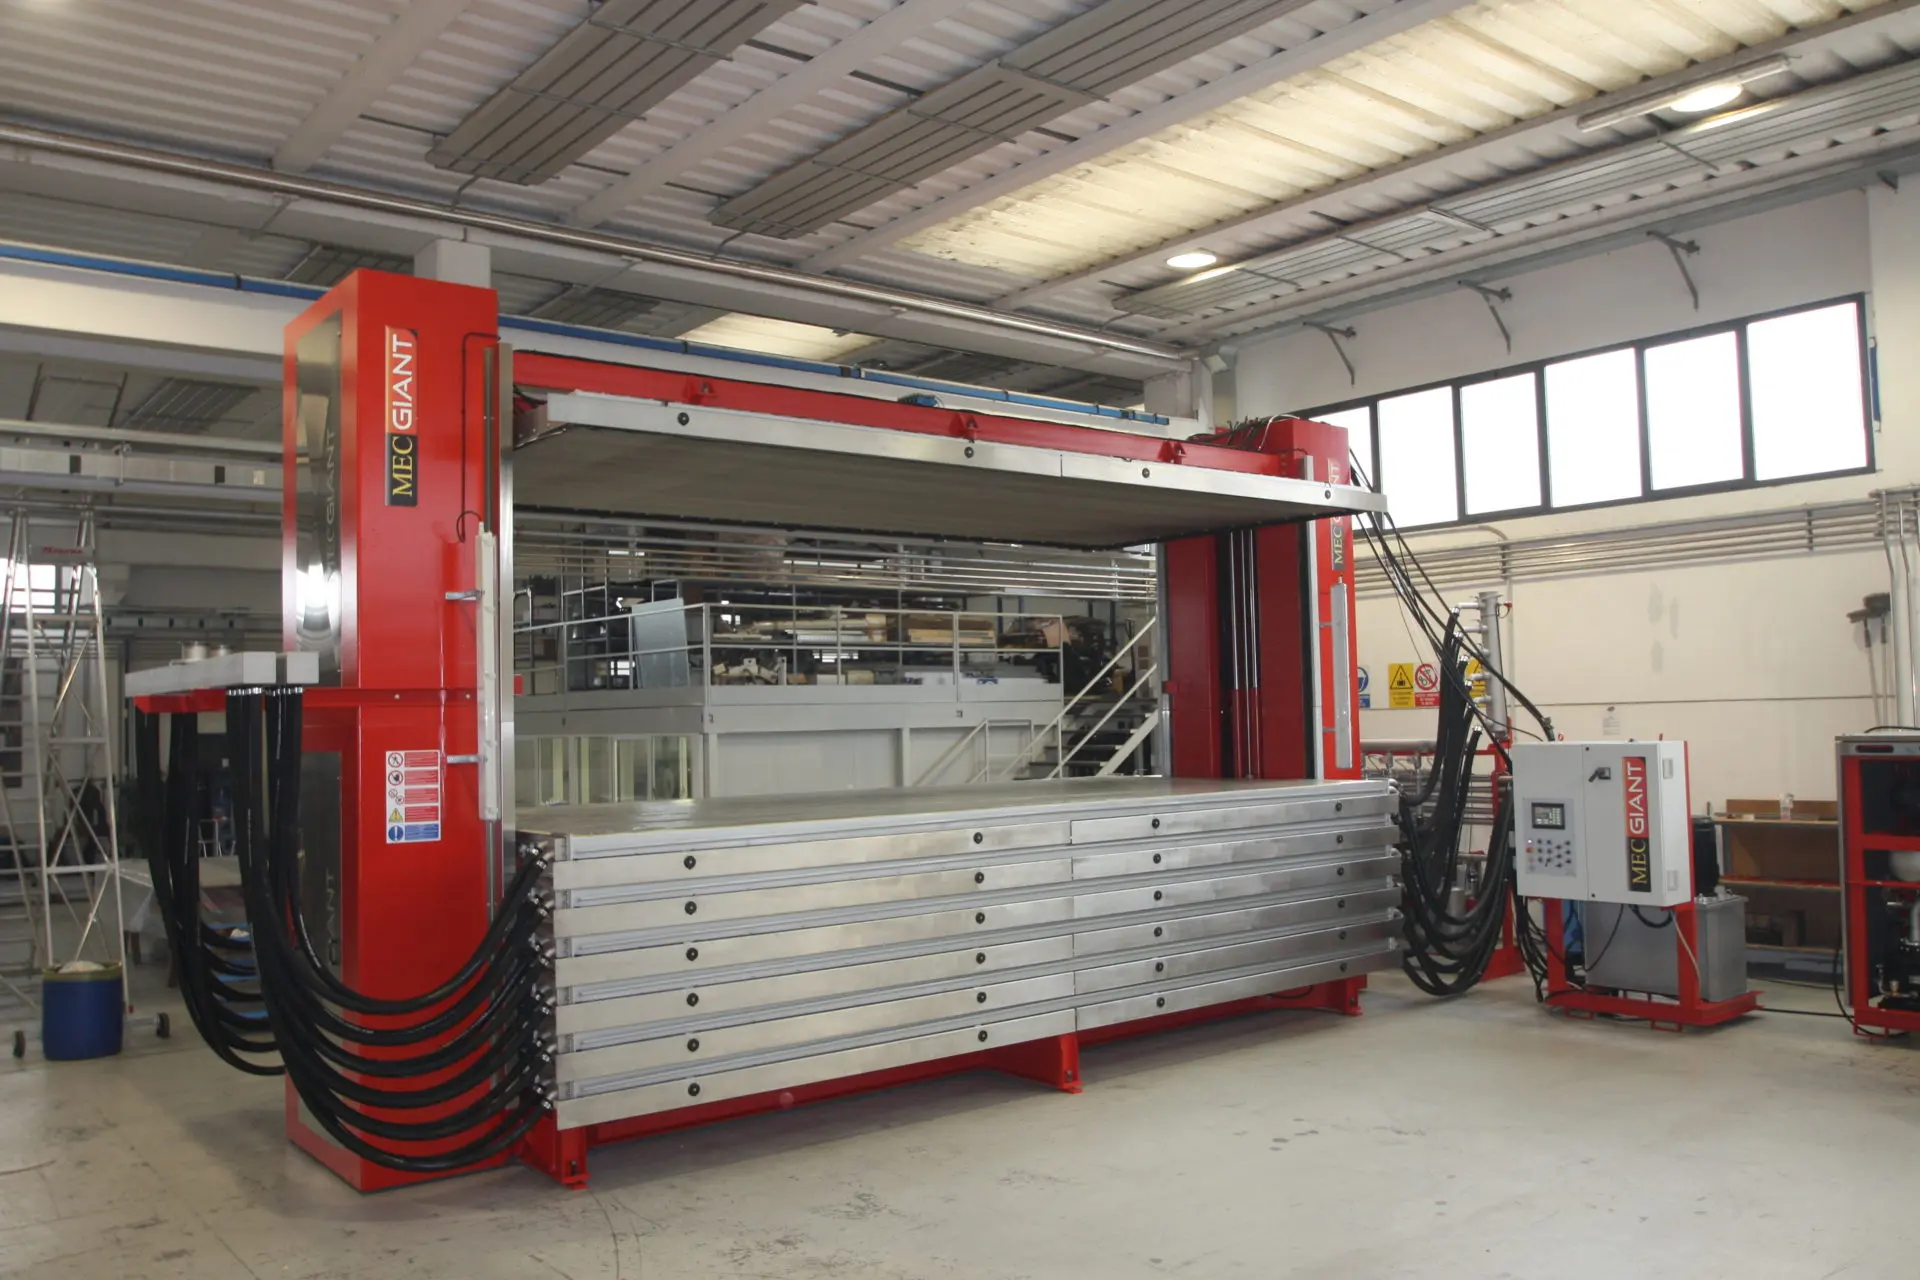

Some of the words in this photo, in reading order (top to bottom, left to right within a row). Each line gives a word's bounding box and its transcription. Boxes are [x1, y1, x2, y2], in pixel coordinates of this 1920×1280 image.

[392, 334, 413, 431] GIANT
[392, 436, 413, 497] MEC
[1333, 527, 1344, 565] MEC
[1627, 761, 1645, 835] GIANT
[1630, 838, 1648, 884] MEC
